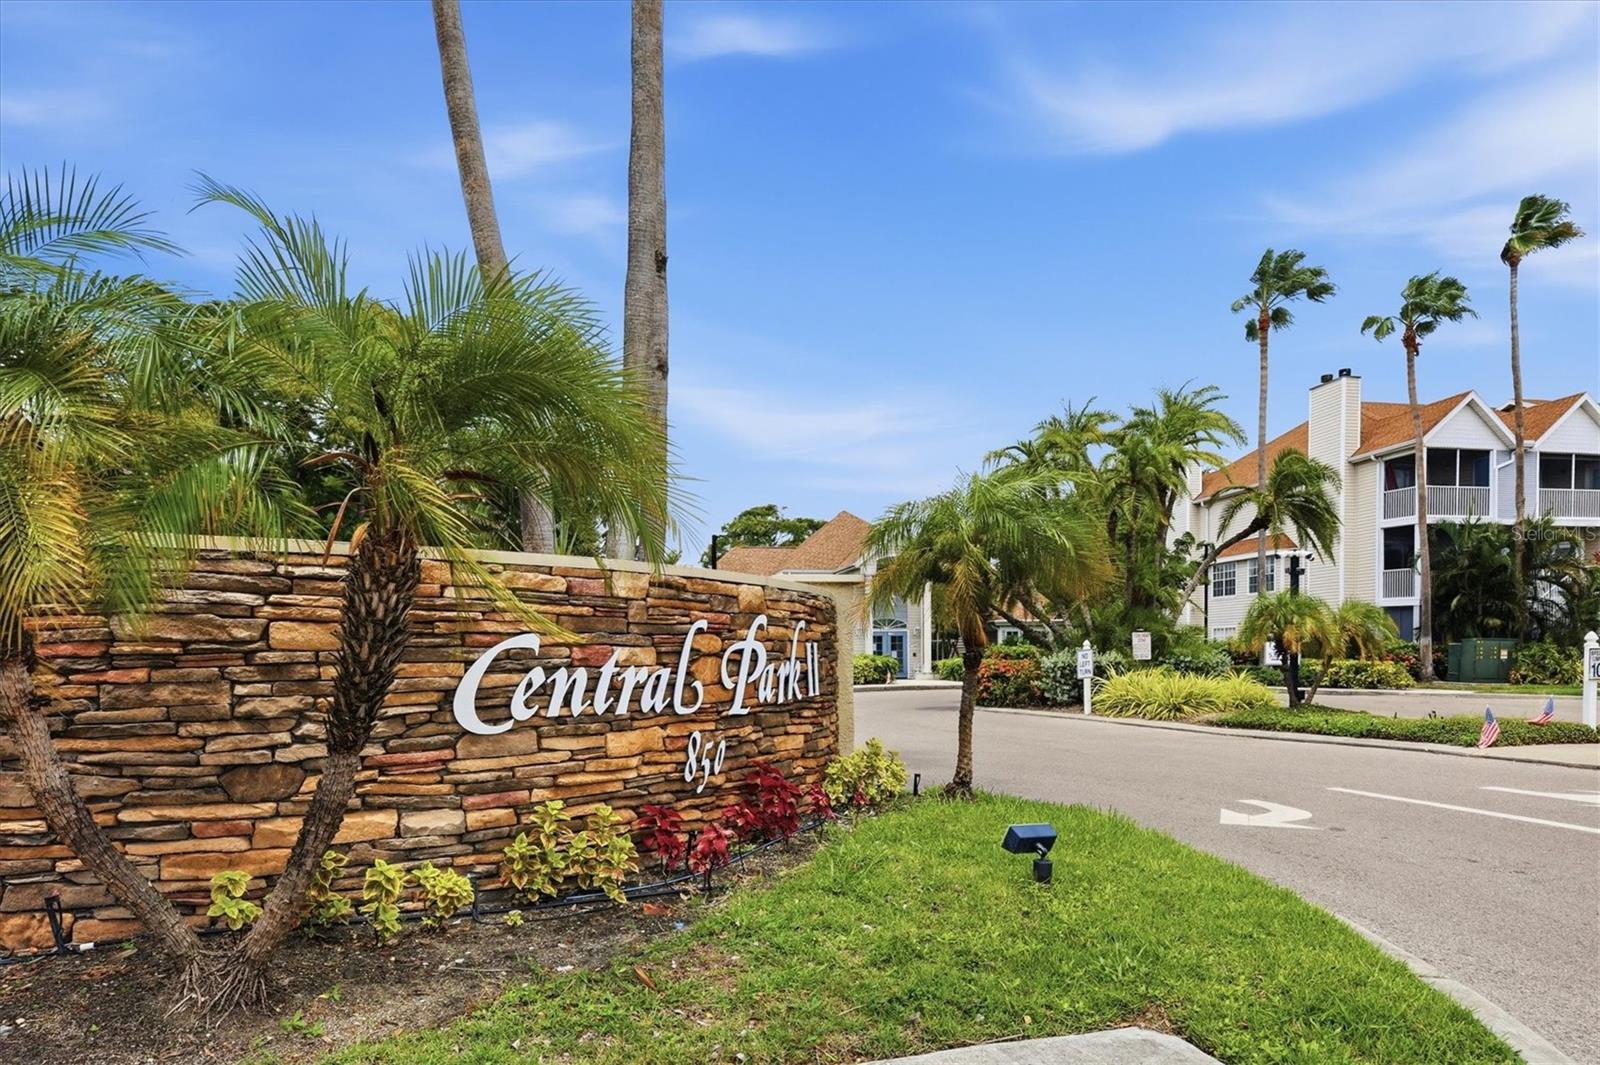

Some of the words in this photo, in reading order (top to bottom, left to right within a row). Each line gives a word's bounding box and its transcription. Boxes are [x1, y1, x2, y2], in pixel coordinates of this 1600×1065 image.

[1081, 652, 1089, 660] NO
[1079, 660, 1091, 668] LEFT
[452, 619, 708, 736] Central
[720, 614, 806, 717] Park
[1079, 668, 1092, 676] TURN
[684, 730, 726, 793] 850
